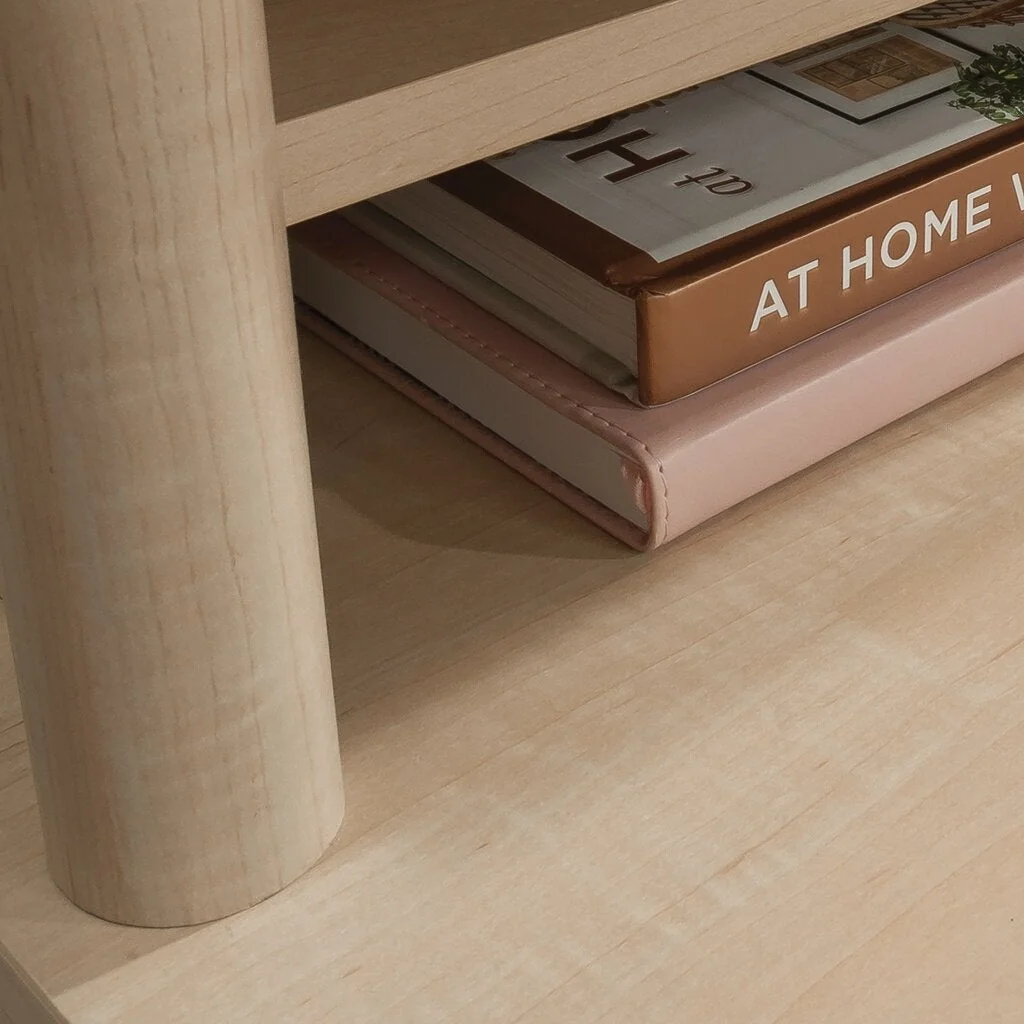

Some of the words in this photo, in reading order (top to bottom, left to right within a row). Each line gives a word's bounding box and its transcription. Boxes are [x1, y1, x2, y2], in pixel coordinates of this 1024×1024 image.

[672, 165, 757, 196] at
[750, 259, 819, 333] AT
[841, 184, 993, 291] HOME
